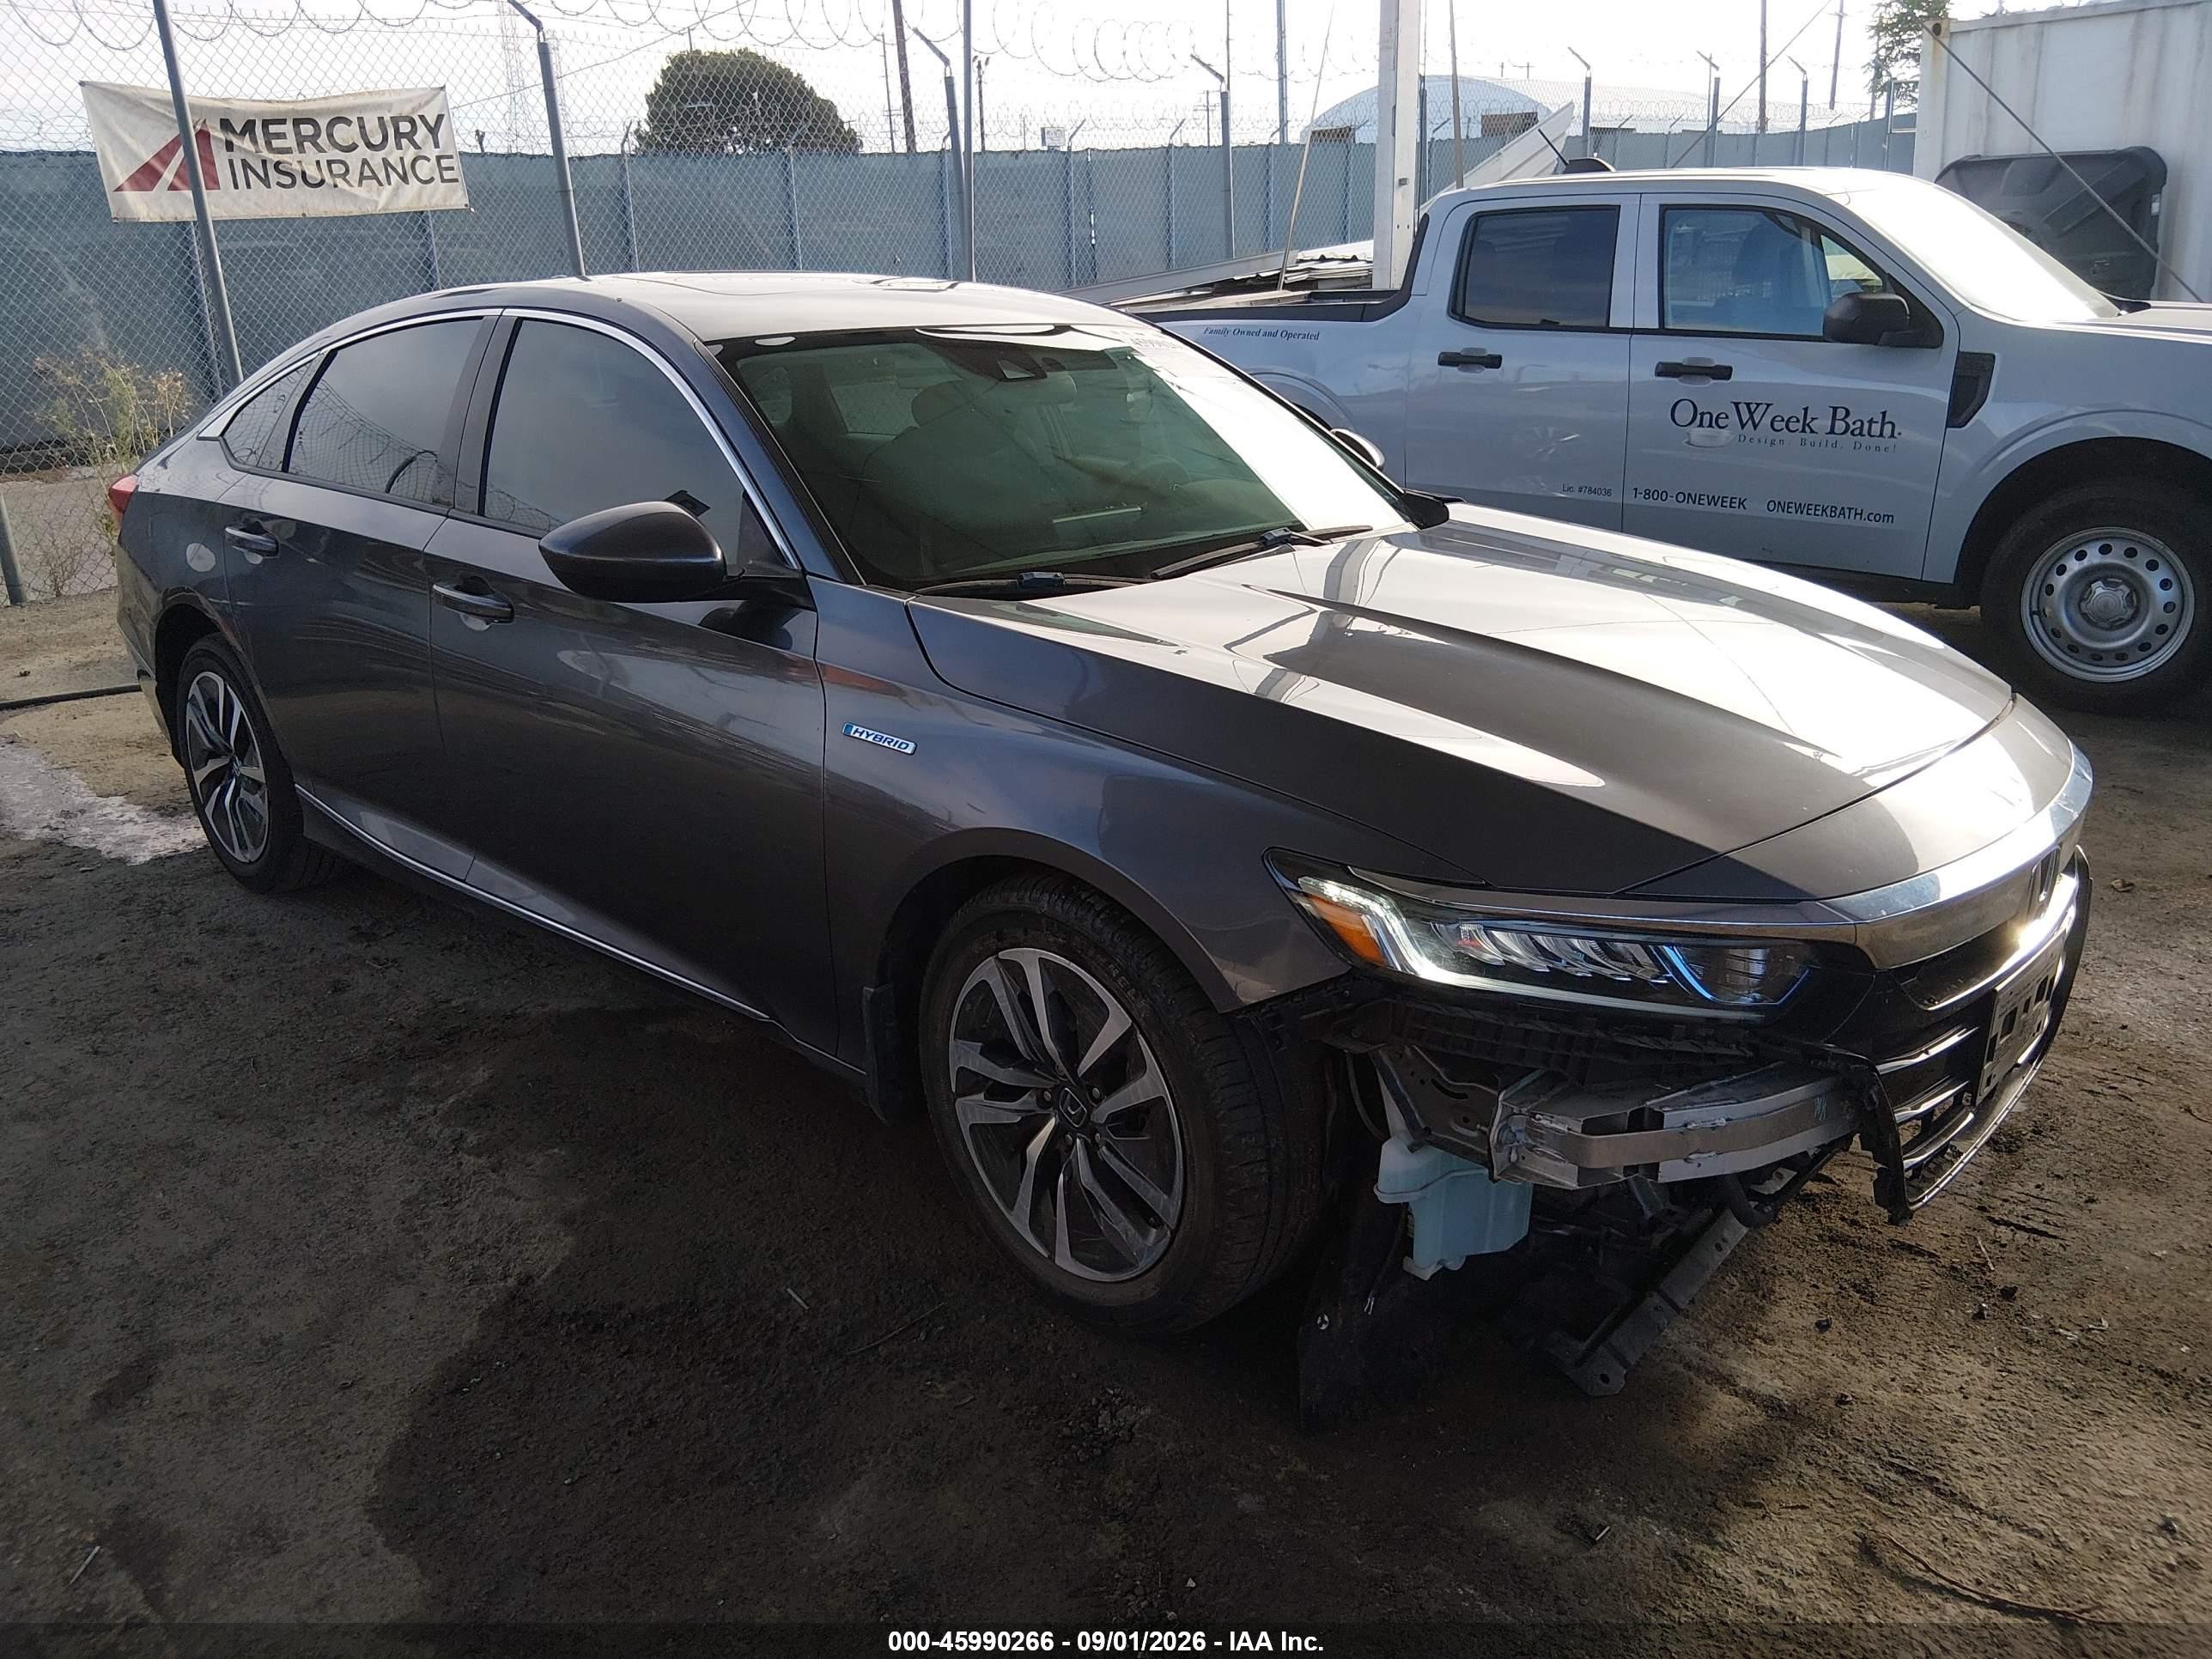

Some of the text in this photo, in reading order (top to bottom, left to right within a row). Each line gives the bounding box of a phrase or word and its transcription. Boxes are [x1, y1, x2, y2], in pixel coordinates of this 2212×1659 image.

[219, 114, 445, 155] MERCURY
[228, 155, 459, 190] INSURANCE
[1203, 327, 1320, 341] Family Owned and Operated
[1853, 441, 1896, 453] Done!
[1578, 485, 1613, 497] #784036
[1632, 487, 1747, 510] 1-800-ONEWEEK
[1766, 500, 1894, 524] ONEWEEKBATH.com
[853, 728, 909, 750] HYBRID
